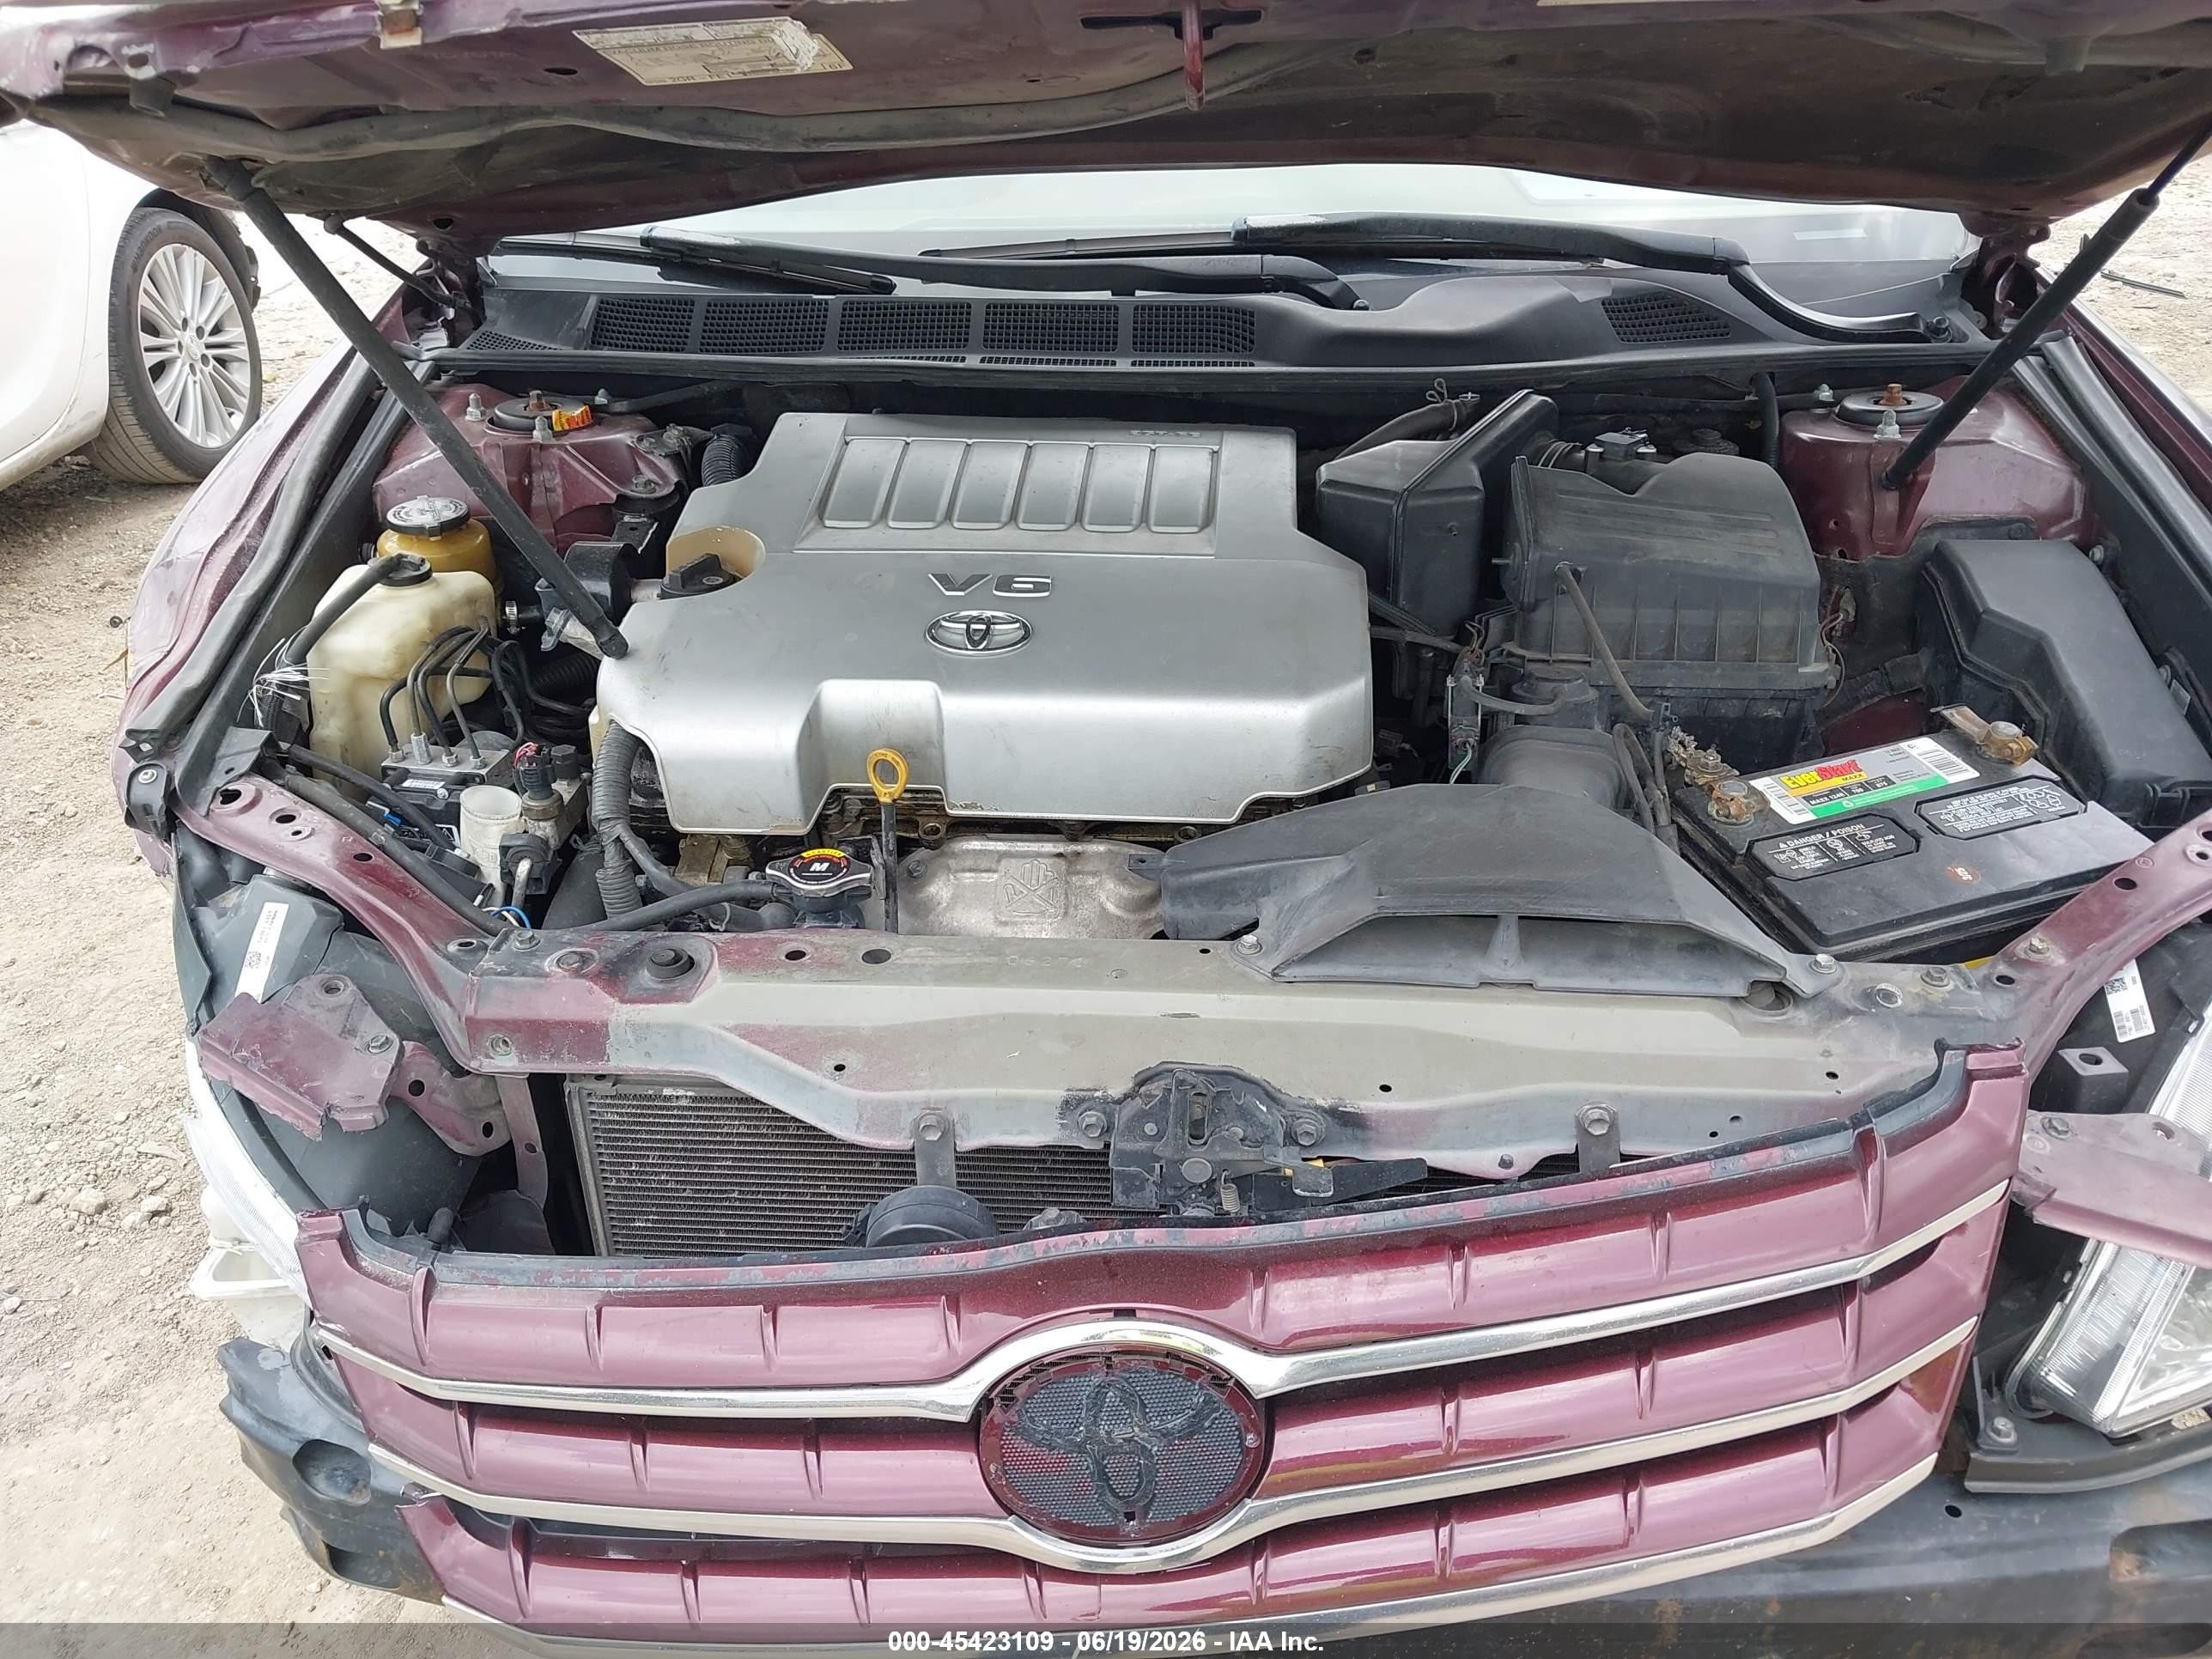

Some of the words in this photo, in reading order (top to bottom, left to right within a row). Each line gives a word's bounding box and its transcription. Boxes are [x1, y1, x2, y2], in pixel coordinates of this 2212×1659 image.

[928, 573, 1053, 598] V6
[1779, 759, 1863, 789] EverStart
[1841, 774, 1863, 782] MAXX
[1786, 832, 1825, 847] DANGER
[1832, 823, 1866, 836] POISON
[809, 862, 830, 872] M
